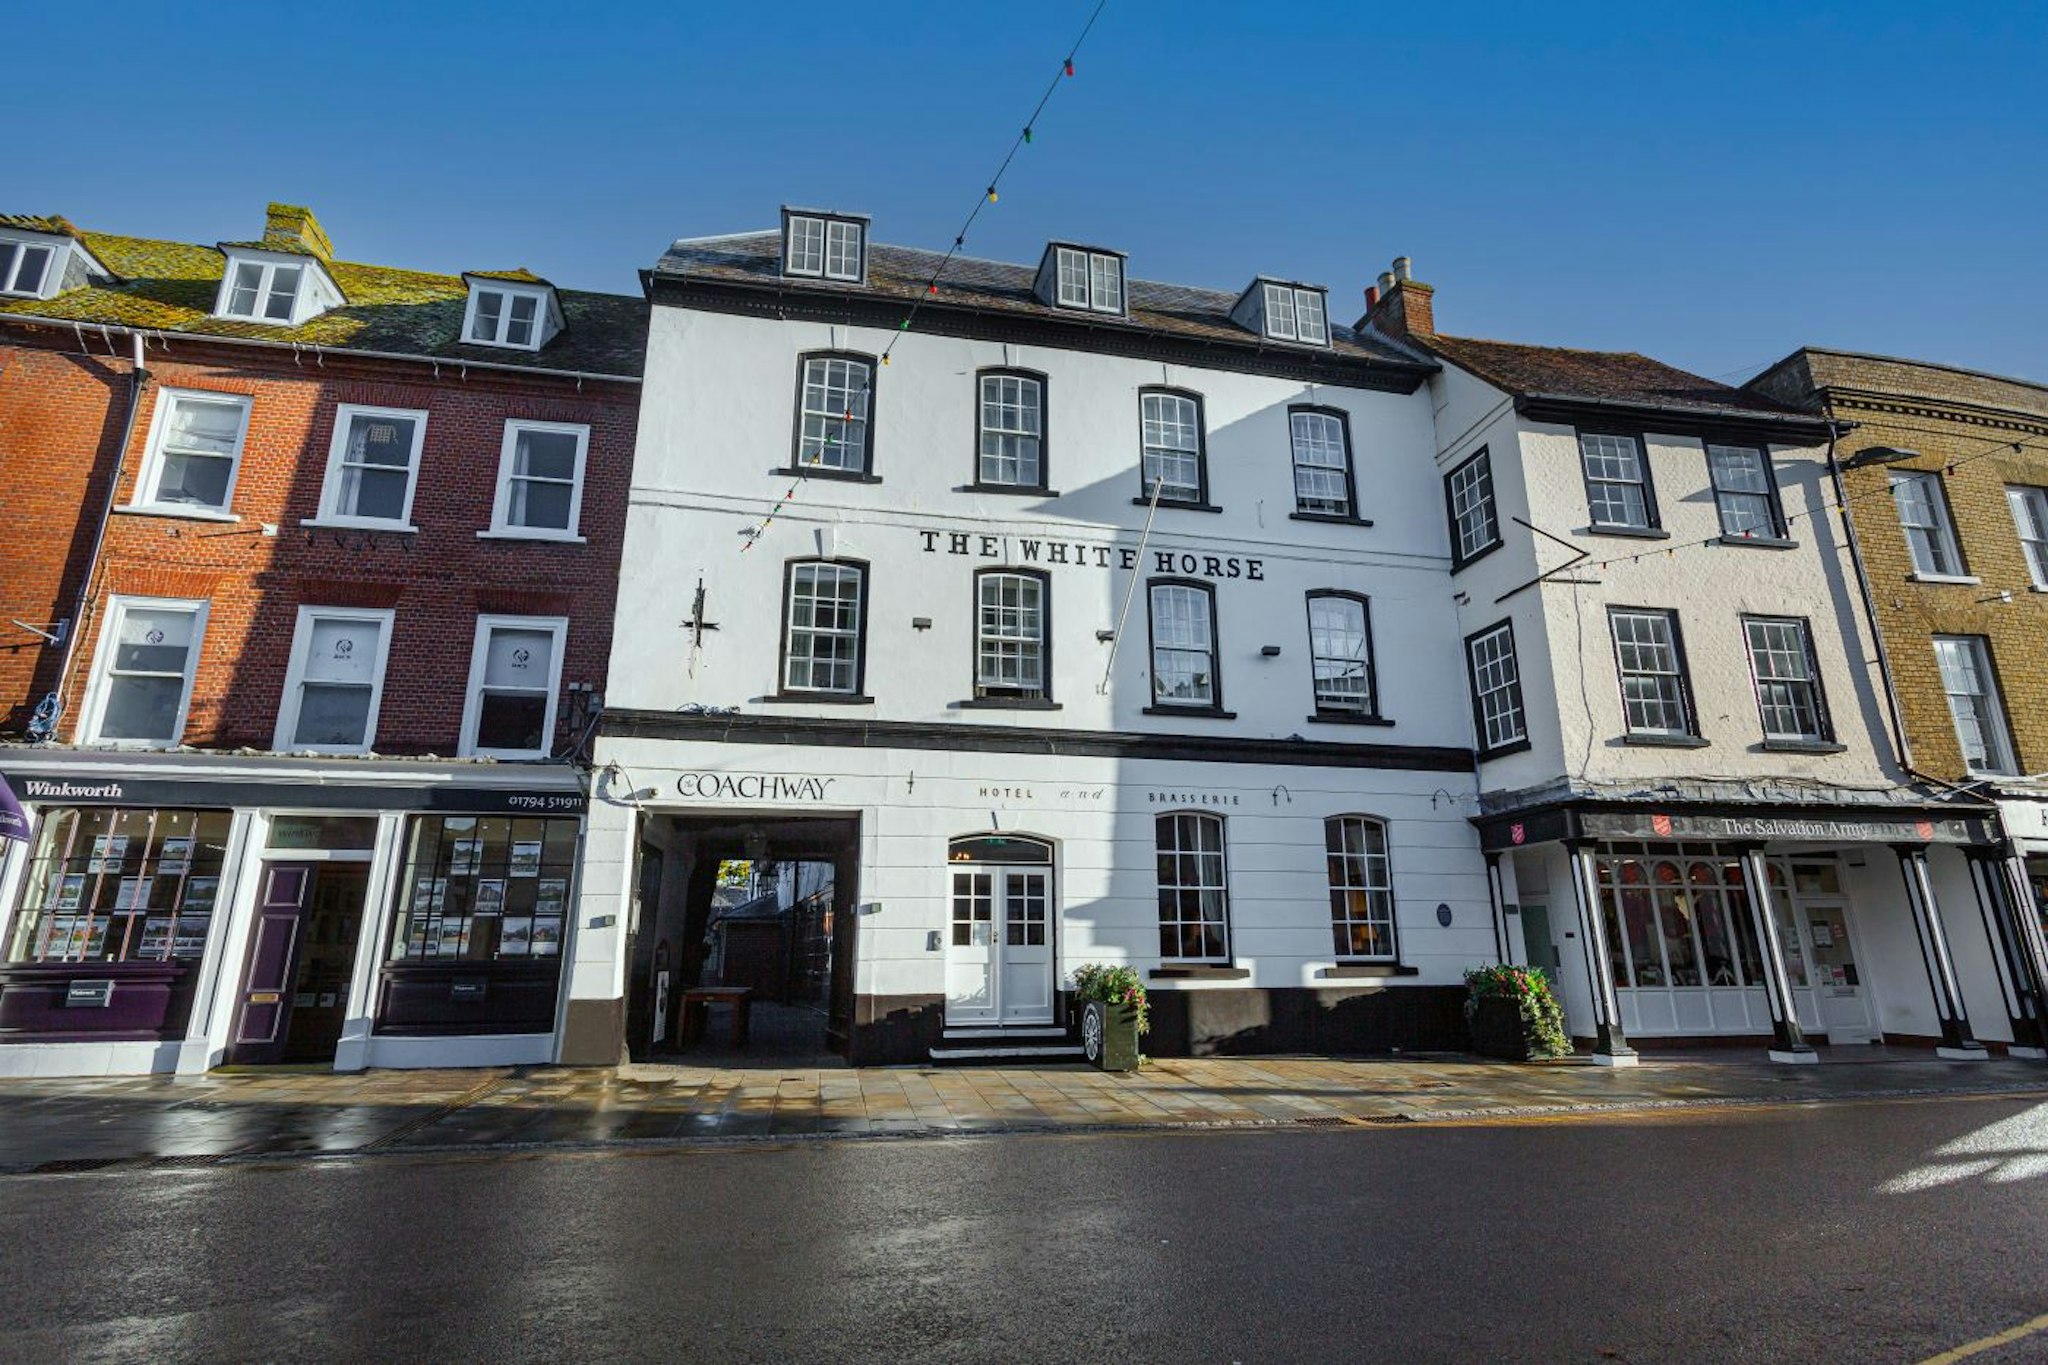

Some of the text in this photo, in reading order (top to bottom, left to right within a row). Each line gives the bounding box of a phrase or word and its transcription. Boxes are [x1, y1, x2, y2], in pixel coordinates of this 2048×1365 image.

[920, 530, 1265, 581] THE WHITE HORSE
[25, 780, 122, 797] Winkworth
[677, 772, 836, 800] COACHWAY
[508, 795, 582, 809] 01794 511911
[979, 787, 1239, 806] HOTEL and BRASSERIE
[1721, 818, 1868, 840] The Salvation Army
